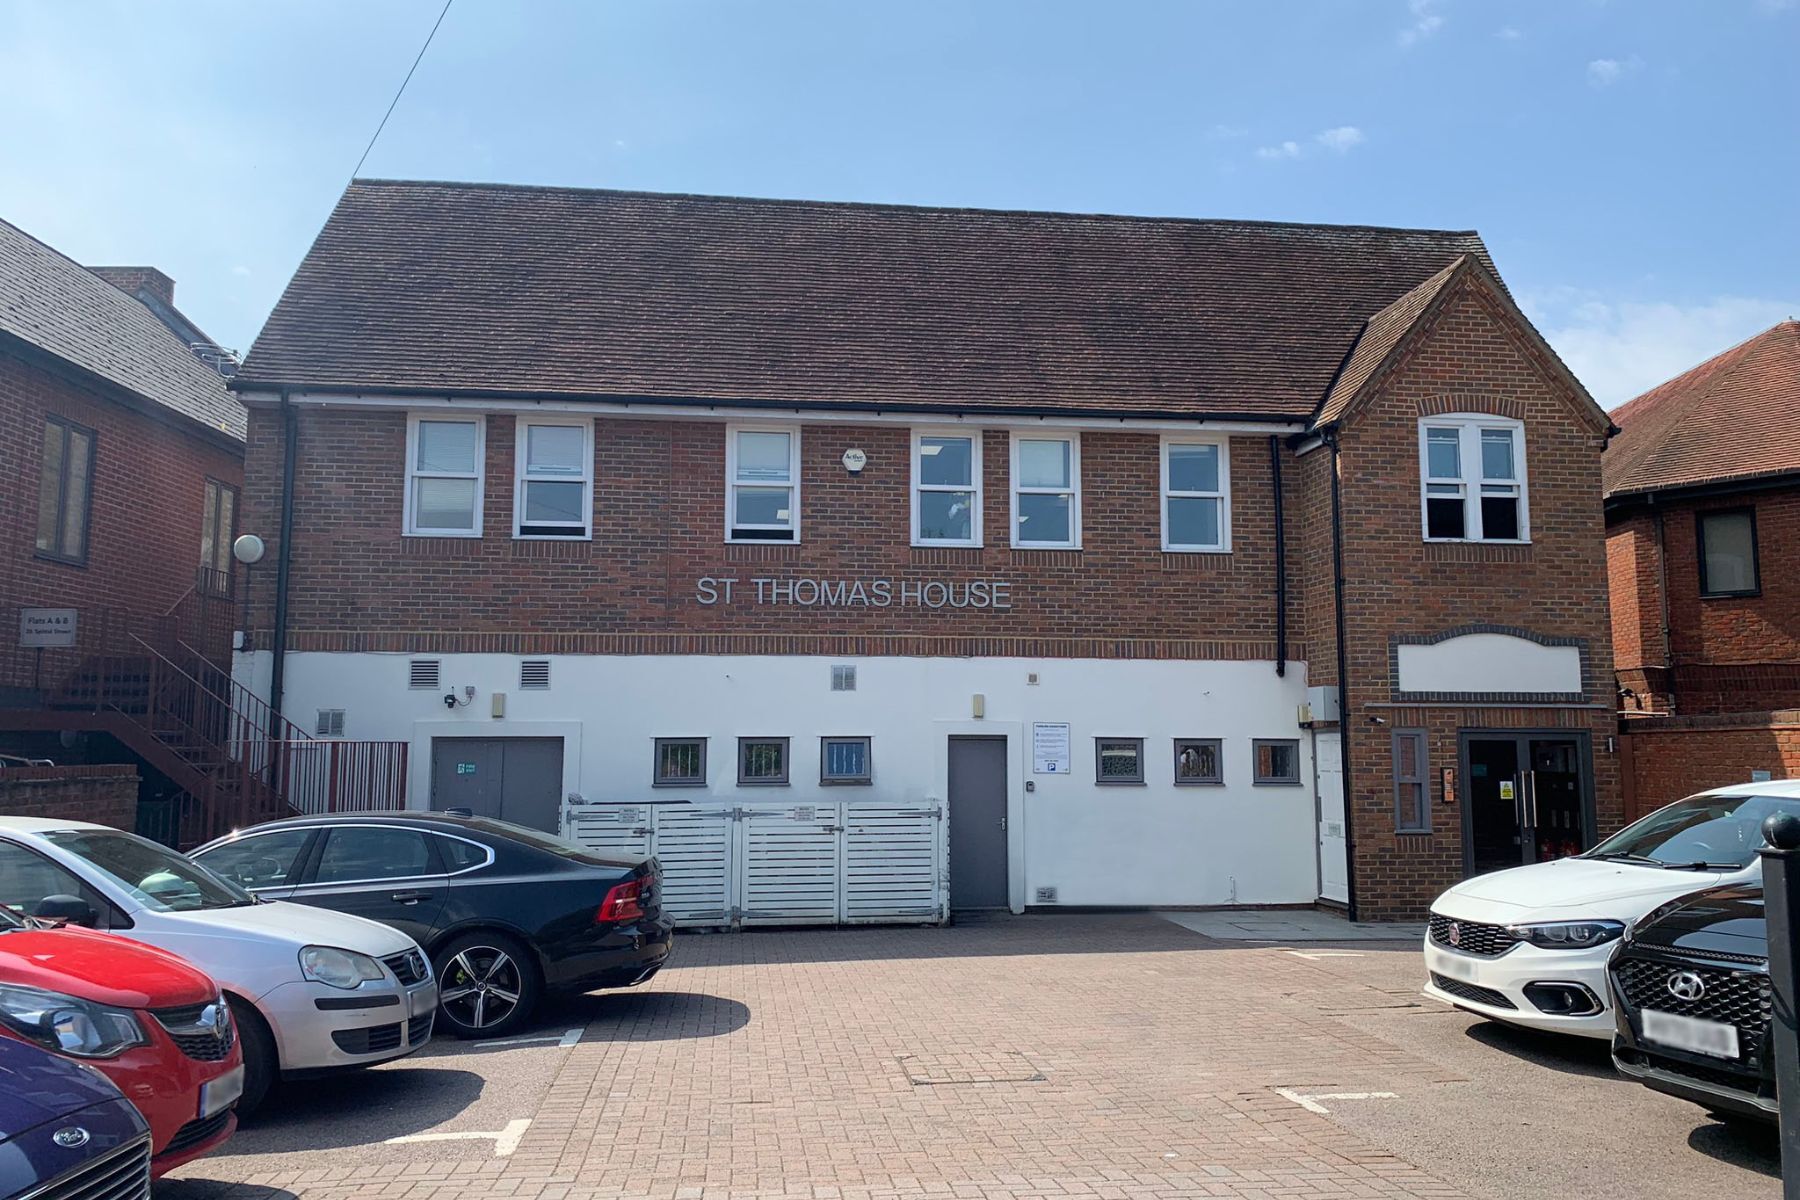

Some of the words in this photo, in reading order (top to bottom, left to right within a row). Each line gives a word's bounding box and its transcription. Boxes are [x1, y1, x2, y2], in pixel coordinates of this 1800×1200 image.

[696, 577, 739, 605] ST
[750, 579, 893, 607] THOMAS
[901, 582, 1012, 609] HOUSE
[28, 616, 46, 624] Flats
[55, 616, 61, 624] &
